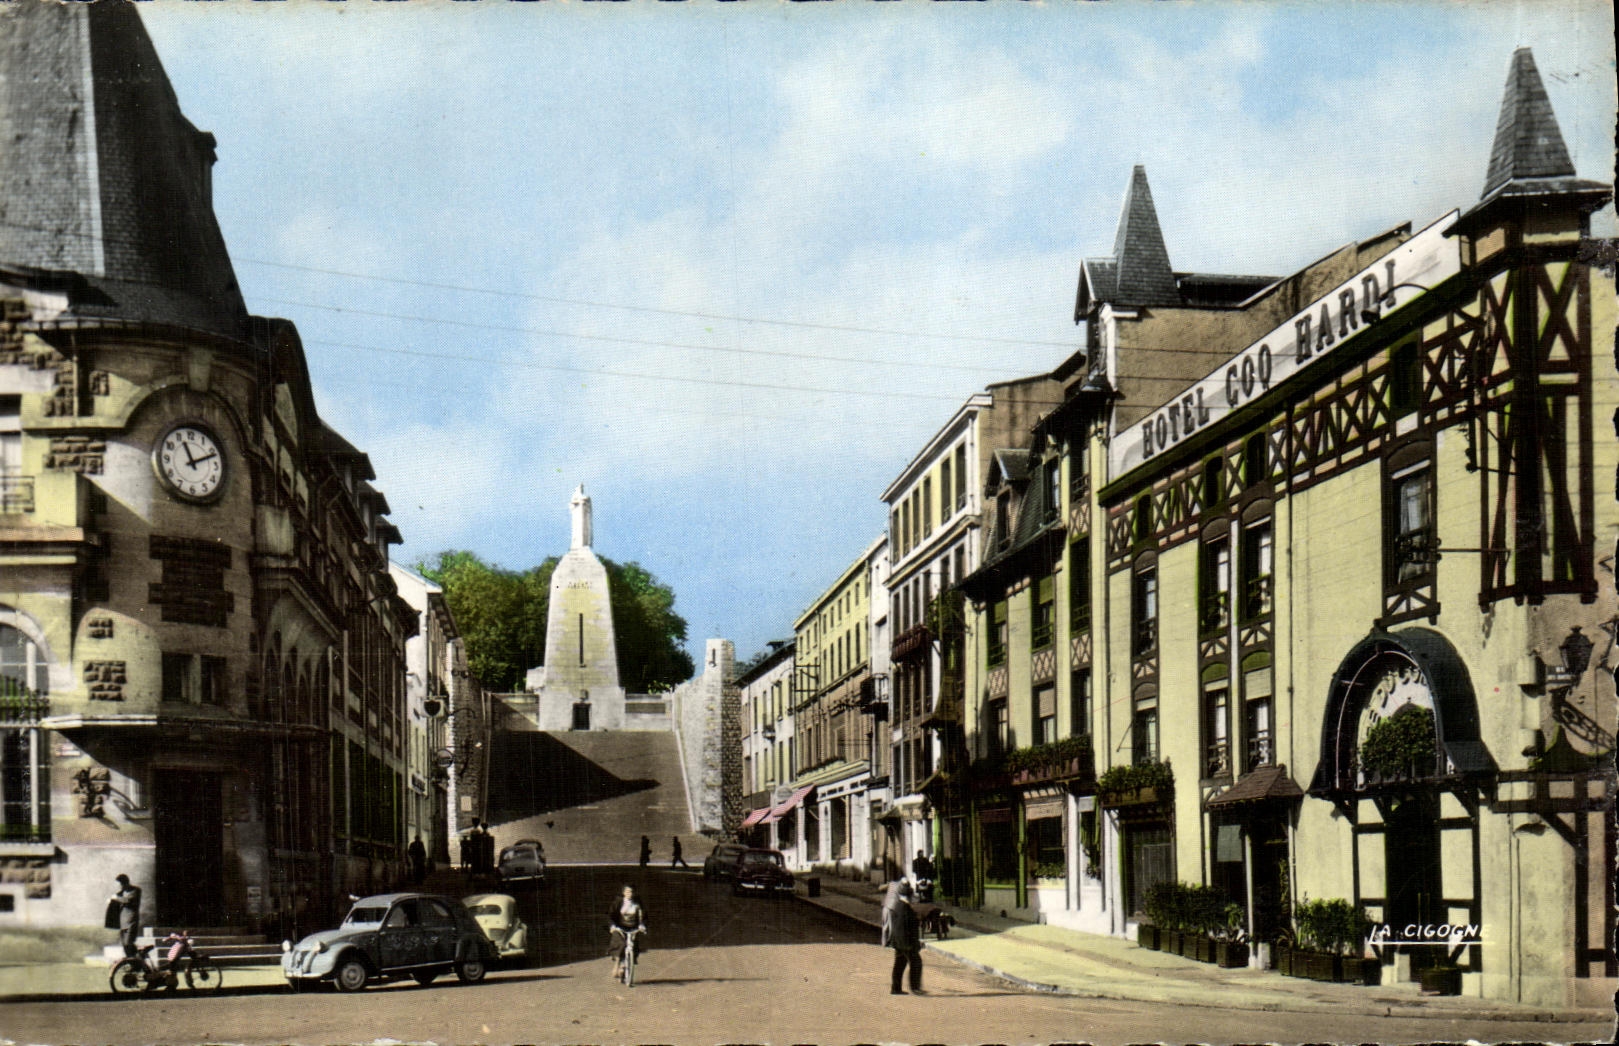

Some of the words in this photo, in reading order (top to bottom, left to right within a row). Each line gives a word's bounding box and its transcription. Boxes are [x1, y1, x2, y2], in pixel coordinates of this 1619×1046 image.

[1142, 387, 1210, 460] HOTEL
[1225, 344, 1273, 409] COQ
[1295, 258, 1397, 365] HARDI
[187, 431, 195, 441] 12
[201, 436, 205, 445] 1
[166, 441, 175, 451] 10
[163, 454, 170, 463] 9
[213, 461, 219, 472] 3
[177, 479, 183, 488] 7
[209, 475, 216, 483] 4
[189, 485, 196, 495] 6
[202, 483, 208, 493] 5
